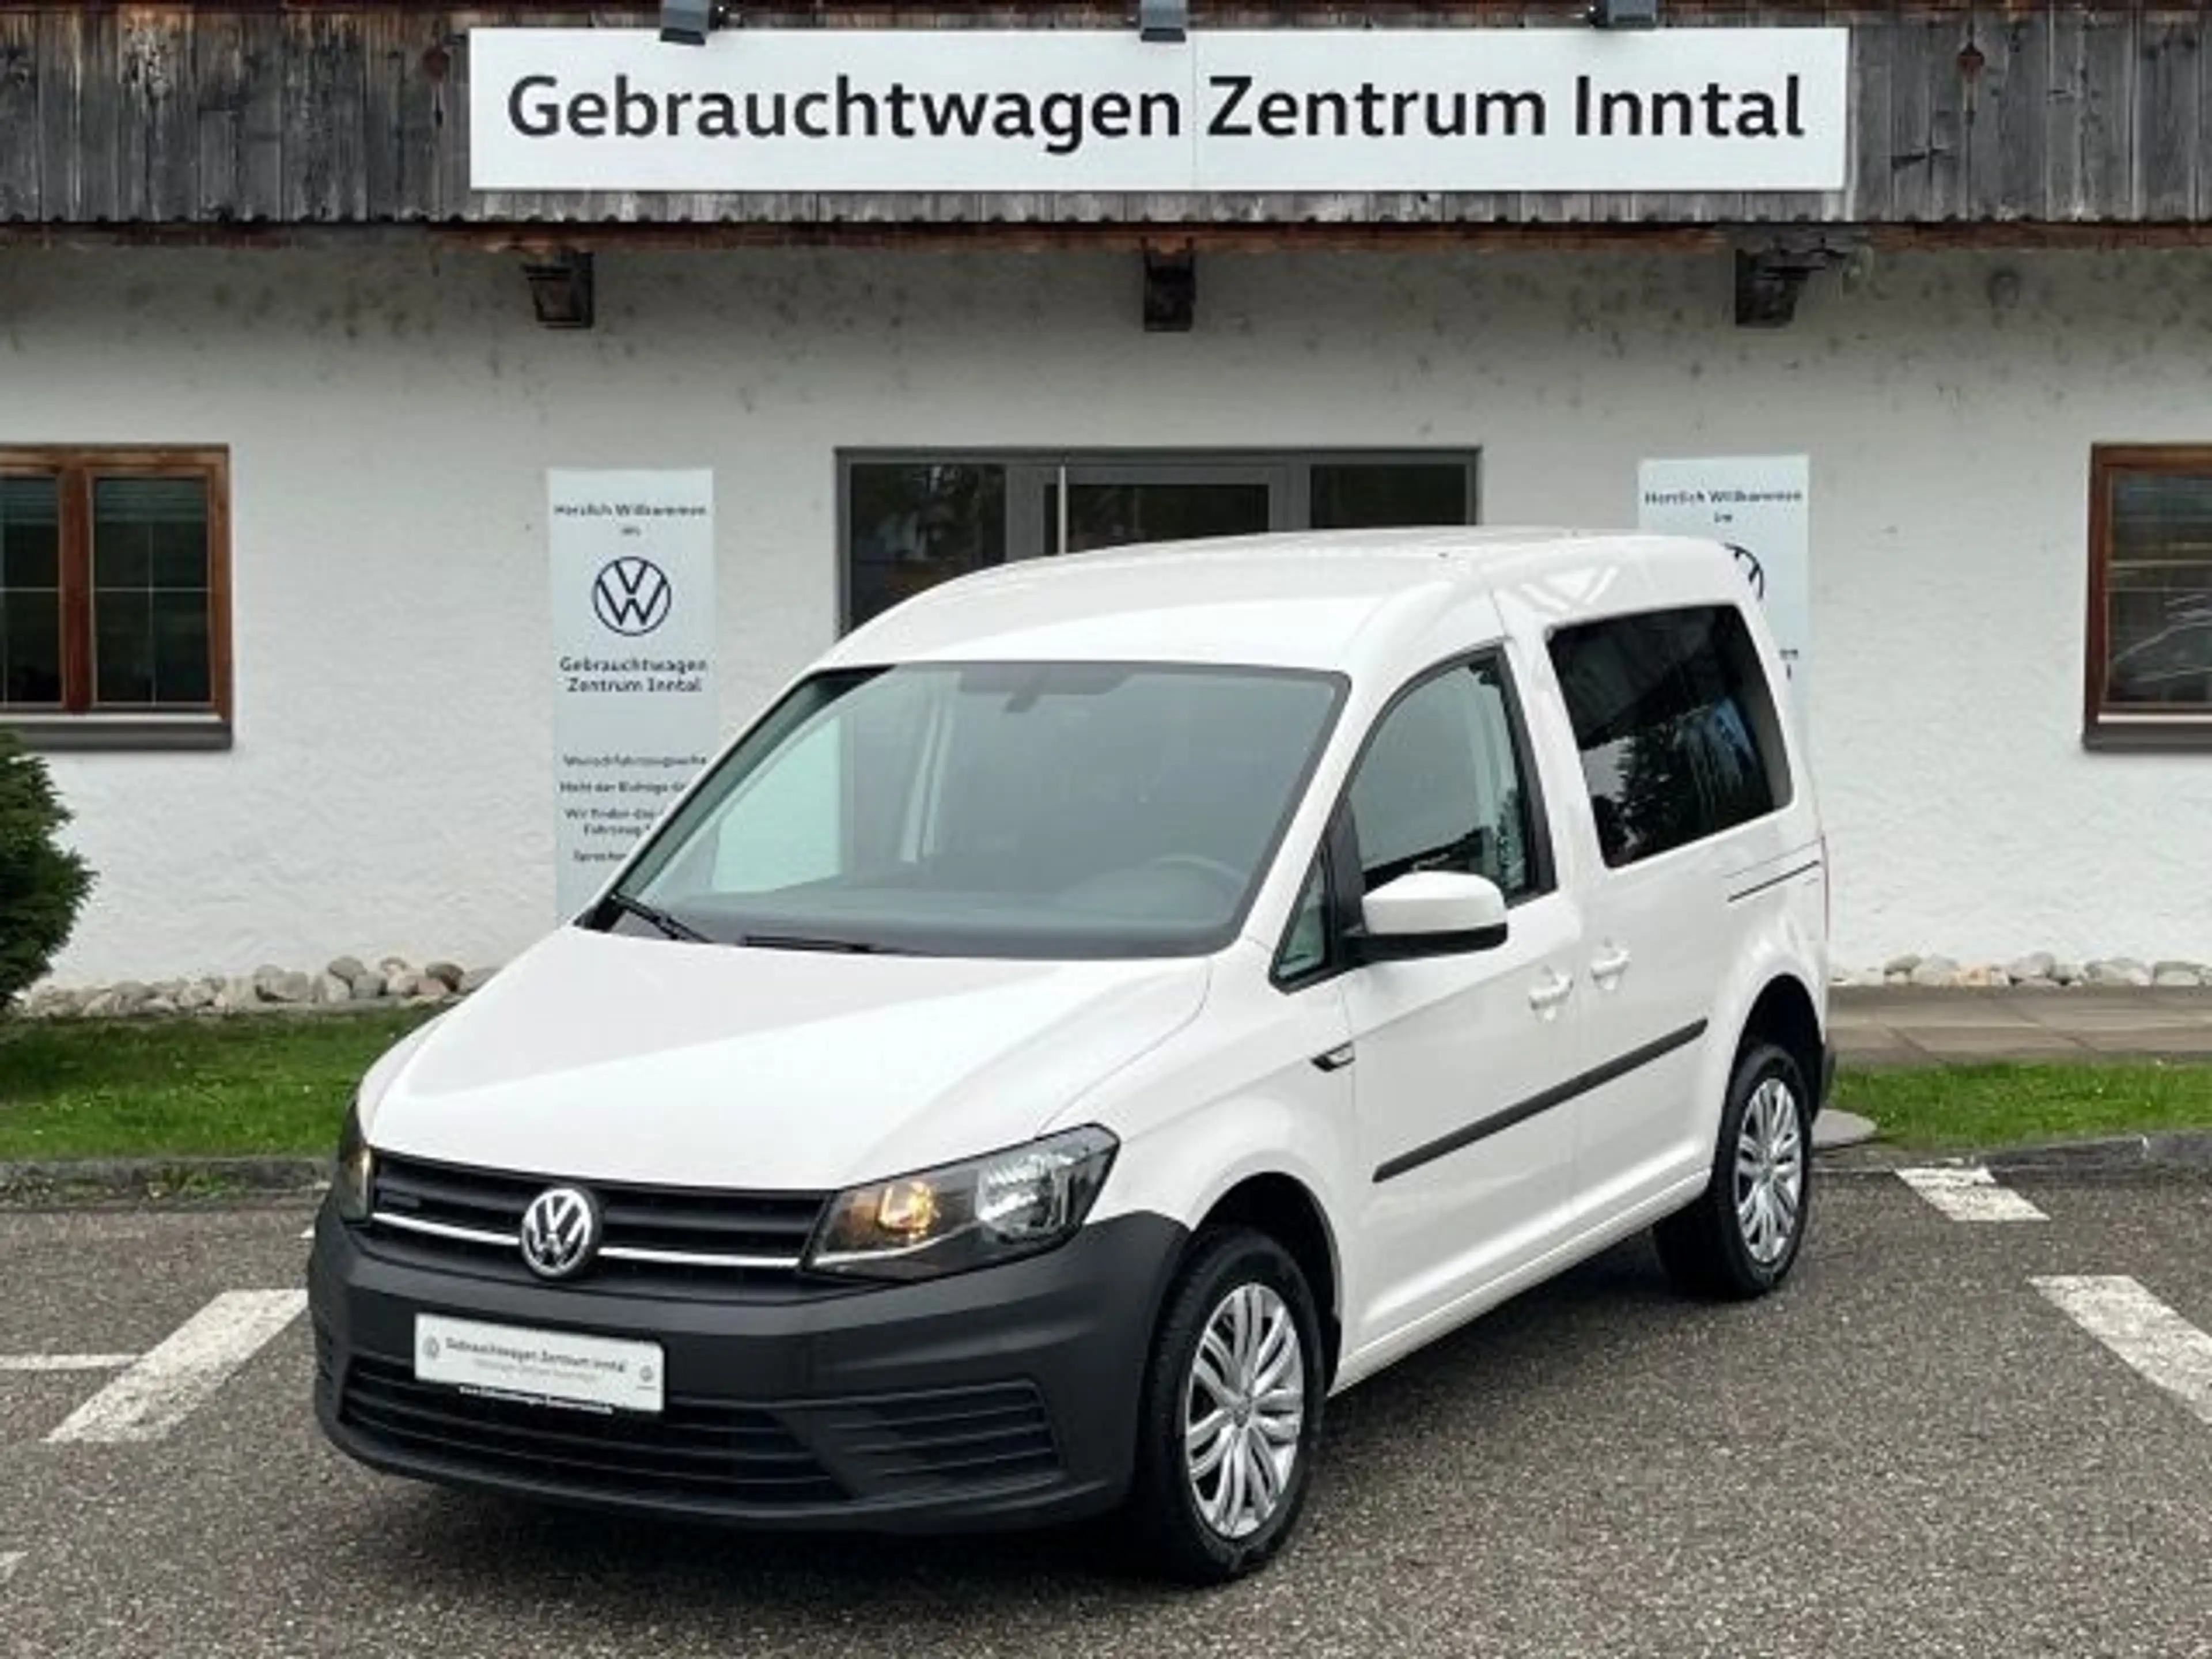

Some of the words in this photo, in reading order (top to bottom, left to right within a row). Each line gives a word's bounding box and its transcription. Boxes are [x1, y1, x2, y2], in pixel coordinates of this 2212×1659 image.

[508, 74, 1180, 156] Gebrauchtwagen
[1207, 75, 1546, 138] Zentrum
[1575, 74, 1805, 138] Inntal
[559, 656, 707, 675] Gebrauchtwagen
[567, 677, 643, 692] Zentrum
[647, 676, 702, 692] Inntal
